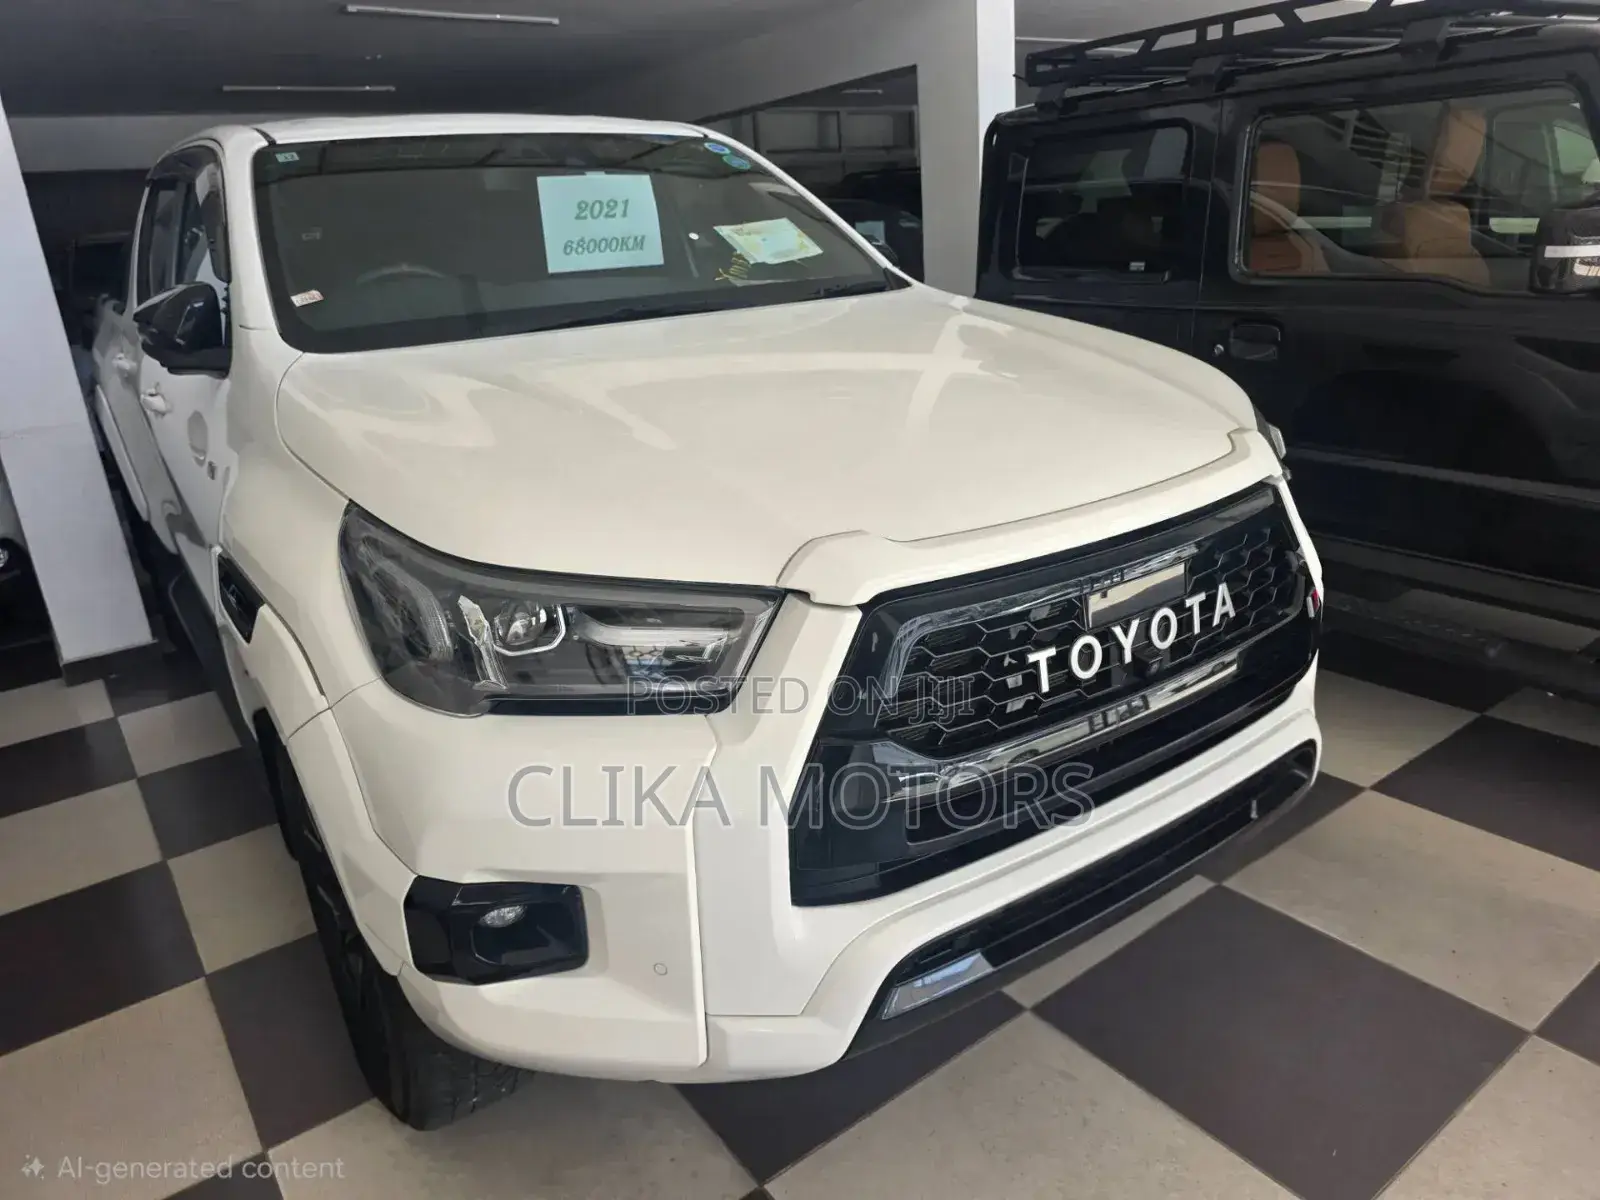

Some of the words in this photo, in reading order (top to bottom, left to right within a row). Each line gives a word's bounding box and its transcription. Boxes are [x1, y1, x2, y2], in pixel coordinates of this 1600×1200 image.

[574, 199, 630, 220] 2021
[563, 235, 646, 256] 68000KM
[1027, 582, 1236, 693] TOYOTA
